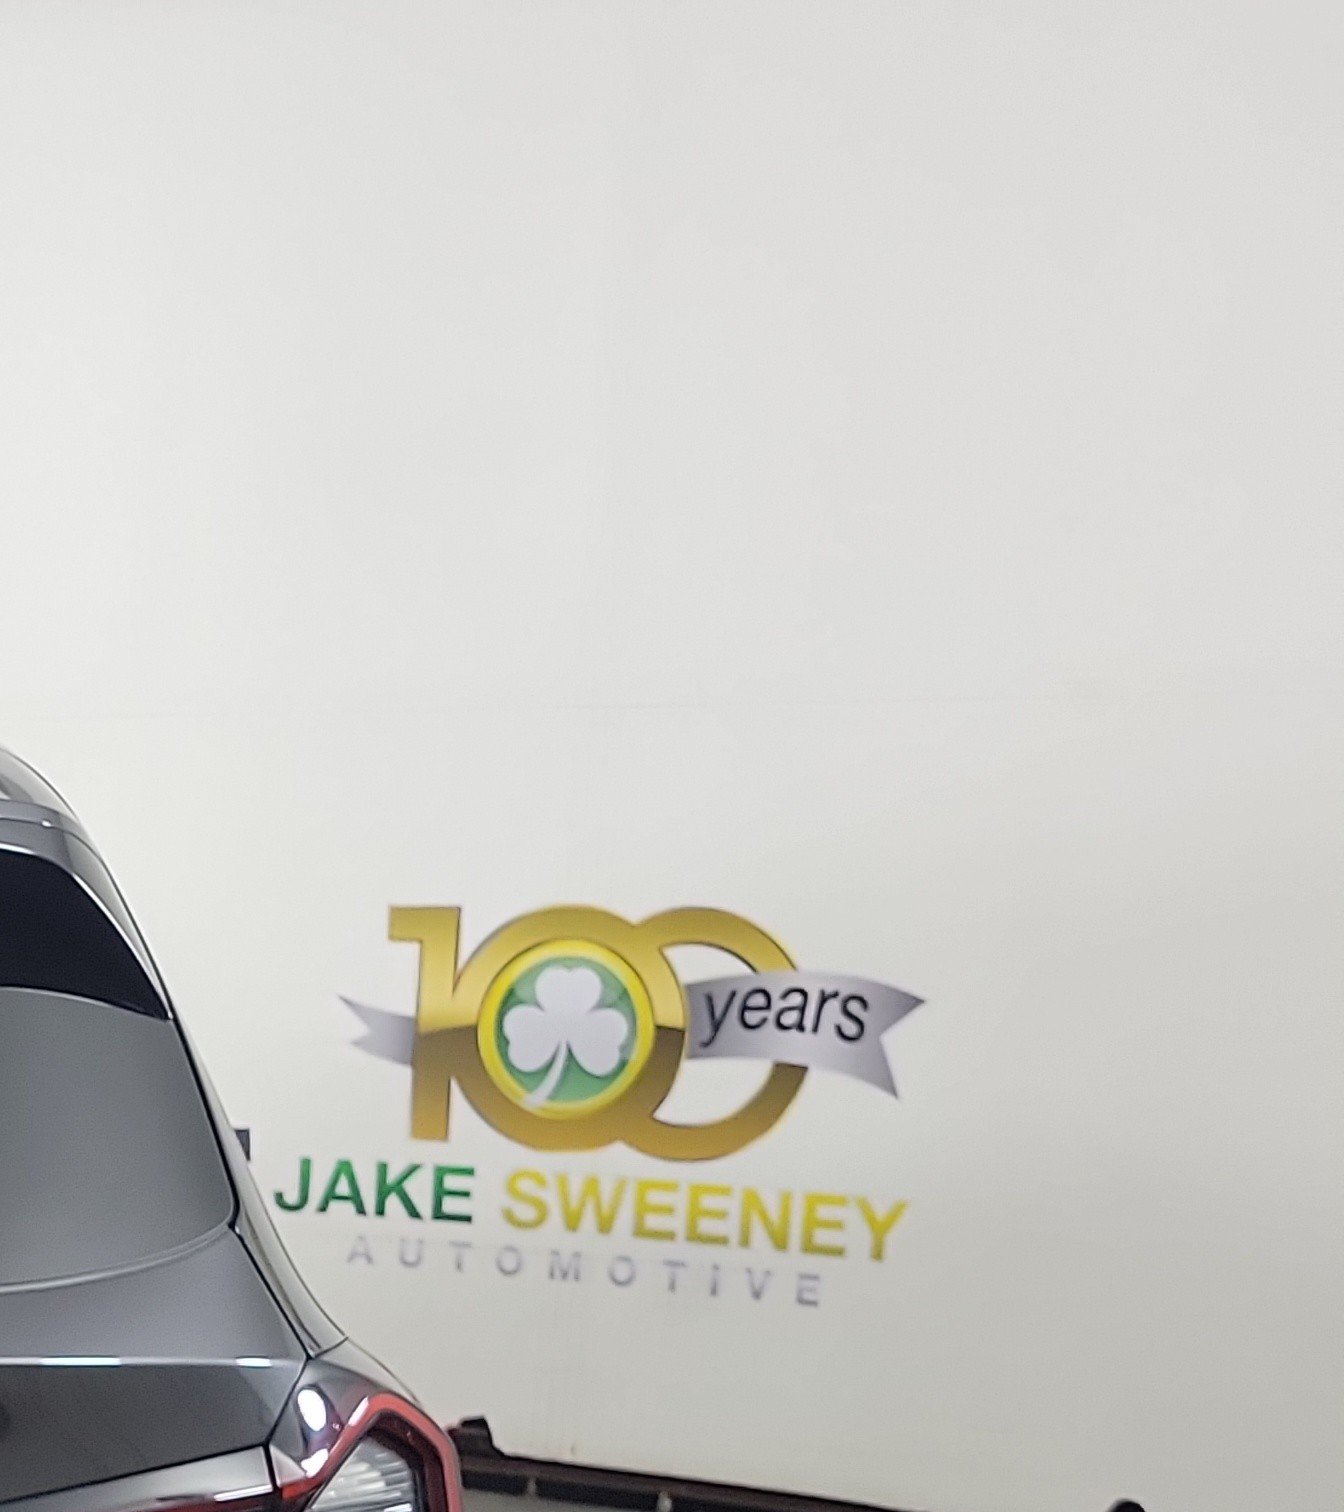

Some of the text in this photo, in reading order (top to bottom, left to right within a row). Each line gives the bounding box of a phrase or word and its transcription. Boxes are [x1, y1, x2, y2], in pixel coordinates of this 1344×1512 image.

[388, 904, 870, 1163] 100 years
[274, 1157, 908, 1261] JAKE SWEENEY
[347, 1235, 823, 1308] AUTOMOTIVE
